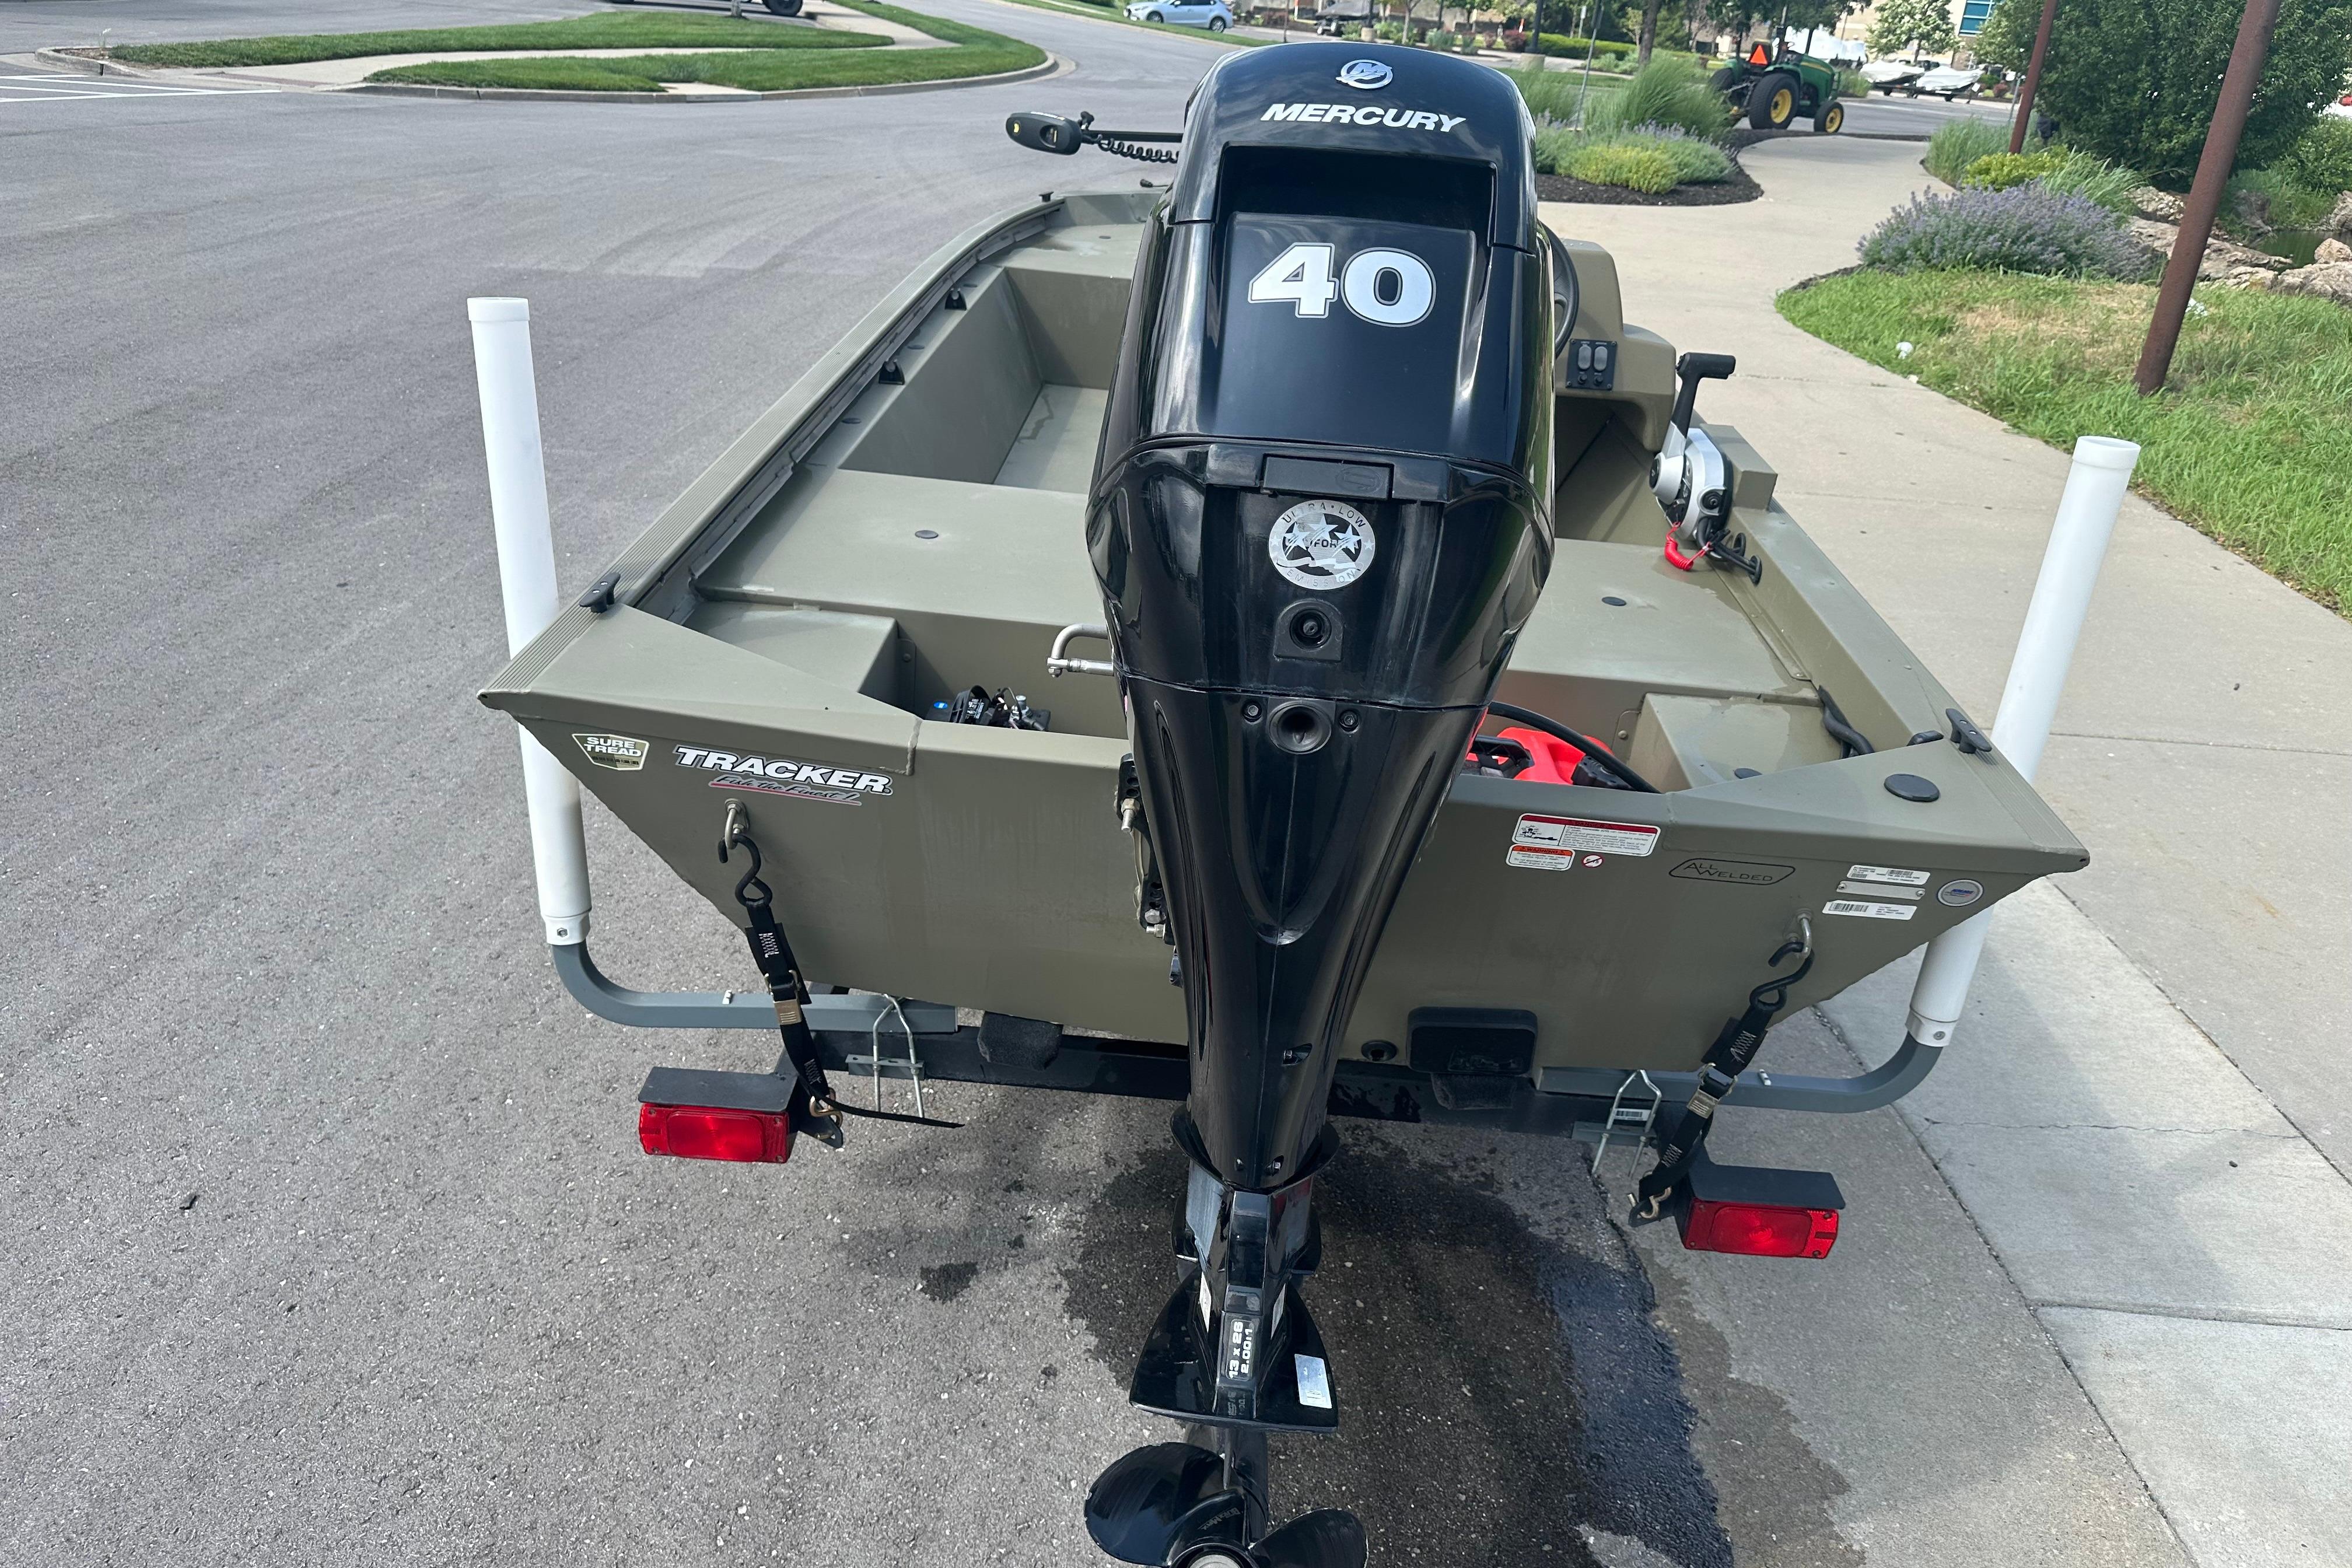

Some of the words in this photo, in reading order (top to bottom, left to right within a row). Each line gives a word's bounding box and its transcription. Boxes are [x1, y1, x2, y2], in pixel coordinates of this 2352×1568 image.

[1261, 103, 1466, 132] MERCURY
[1248, 242, 1437, 327] 40
[1282, 502, 1326, 523] ULTRA
[1338, 505, 1366, 528] LOW
[584, 743, 642, 757] TREAD
[587, 736, 635, 749] SURE
[676, 746, 891, 793] TRACKER
[717, 776, 754, 788] Fish
[757, 778, 783, 790] the
[1684, 862, 1718, 870] ALL
[1696, 869, 1773, 881] WELDED
[1241, 1328, 1253, 1374] 2.00:1
[1229, 1360, 1239, 1378] 13
